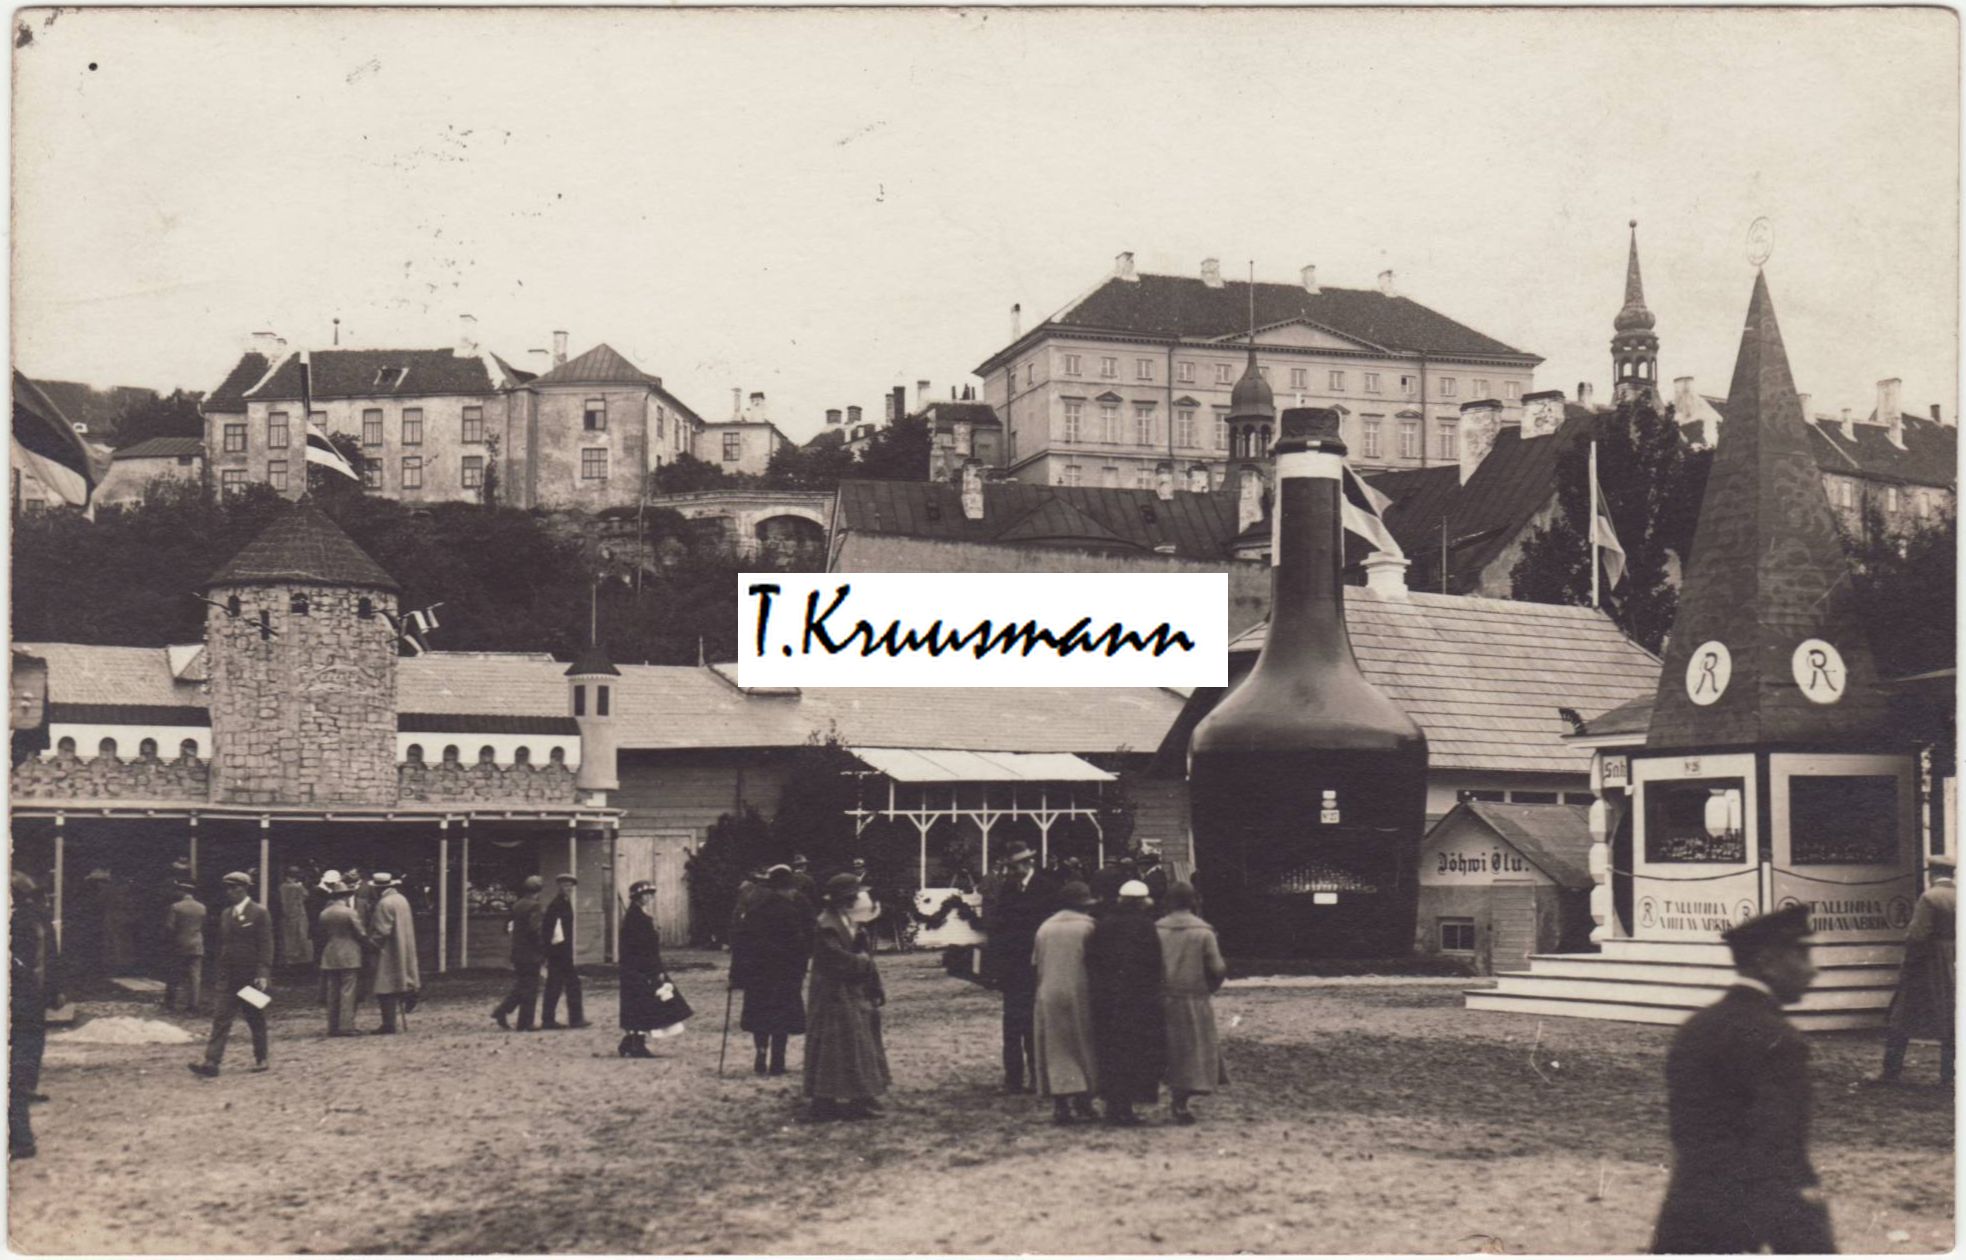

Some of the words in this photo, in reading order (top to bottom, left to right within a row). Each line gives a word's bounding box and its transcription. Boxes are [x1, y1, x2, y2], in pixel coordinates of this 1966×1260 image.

[1695, 652, 1719, 695] R
[1808, 648, 1837, 693] R
[1663, 900, 1727, 915] TALLINNA
[1808, 900, 1883, 914] TALLINNA
